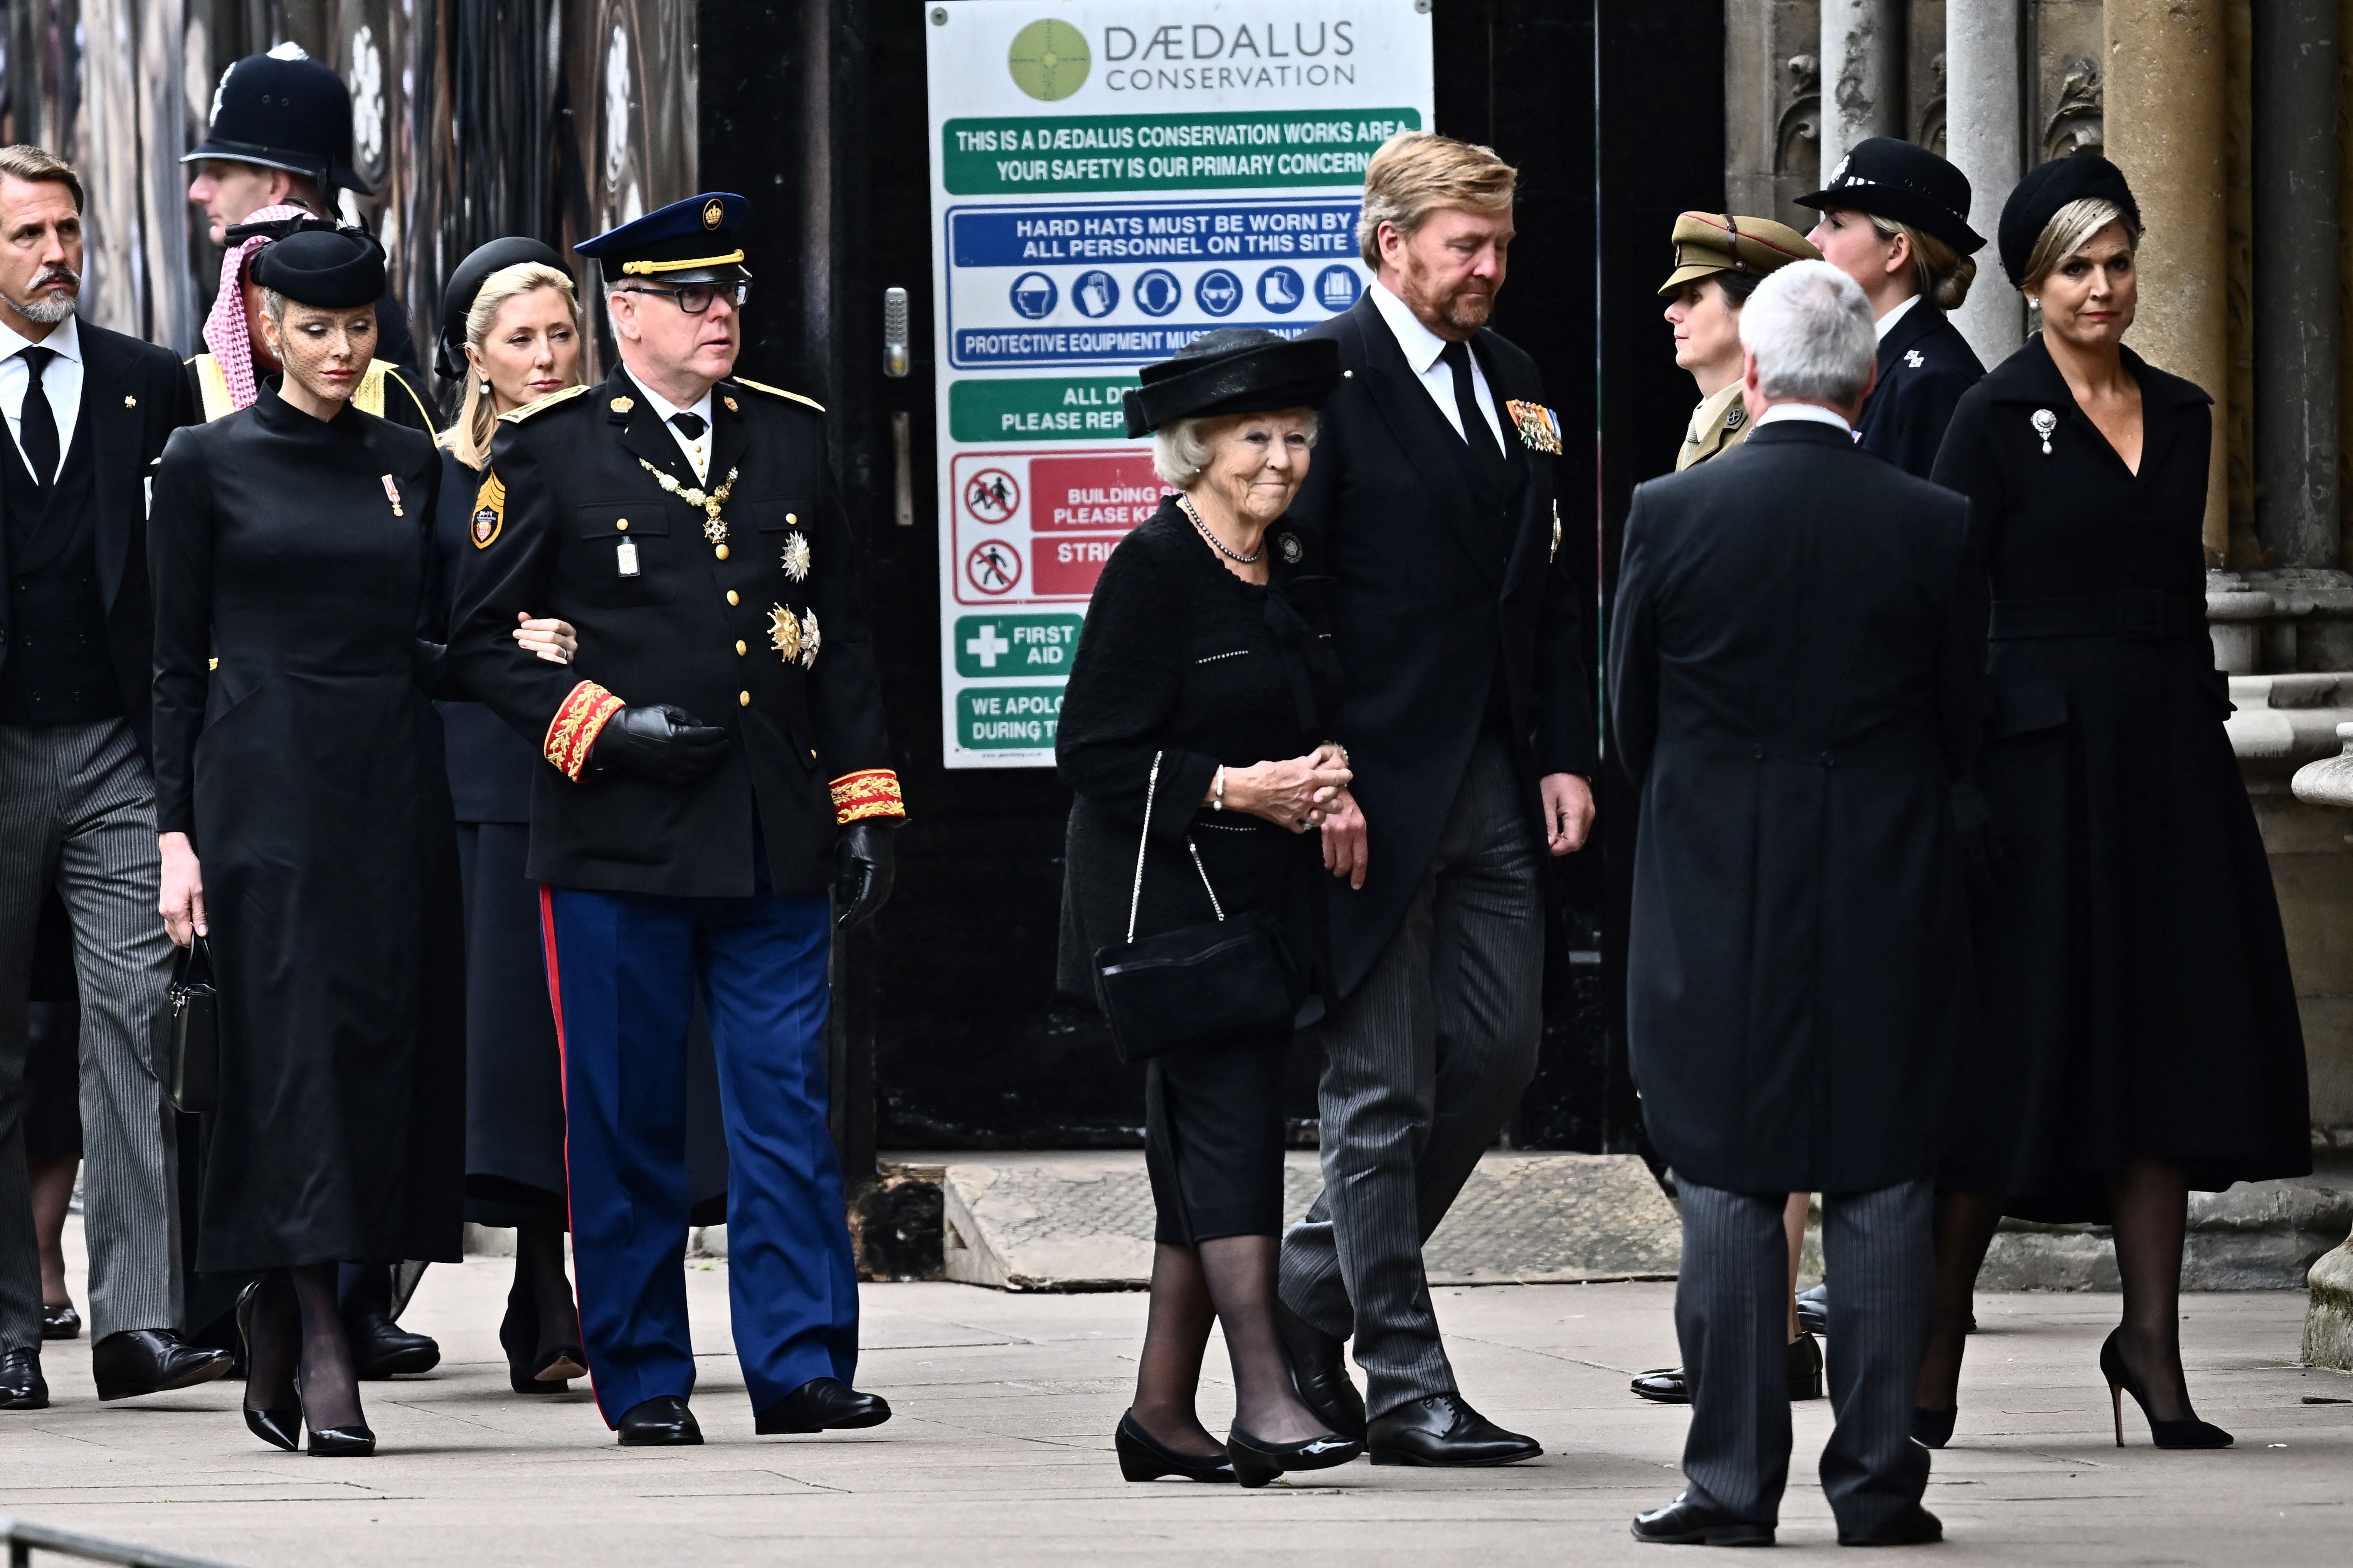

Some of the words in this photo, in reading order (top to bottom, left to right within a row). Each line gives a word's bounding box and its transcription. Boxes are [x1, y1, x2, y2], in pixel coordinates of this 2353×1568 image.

[1105, 20, 1353, 61] DÆDALUS
[1106, 64, 1354, 91] CONSERVATION
[956, 130, 998, 151] THIS
[1001, 130, 1018, 151] IS
[1021, 129, 1034, 150] A
[1038, 126, 1133, 150] DÆDALUS
[1137, 123, 1280, 148] CONSERVATION
[1284, 121, 1354, 144] WORKS
[996, 160, 1048, 181] YOUR
[1051, 158, 1123, 180] SAFETY
[1128, 157, 1145, 178] IS
[1149, 156, 1189, 178] OUR
[1192, 155, 1274, 176] PRIMARY
[1278, 152, 1370, 174] CONCERN
[1017, 219, 1080, 237] HARD
[1084, 217, 1144, 235] HATS
[1148, 215, 1209, 234] MUST
[1214, 215, 1244, 233] BE
[1248, 213, 1318, 232] WORN
[1321, 212, 1351, 230] BY
[1023, 240, 1065, 258] ALL
[1070, 236, 1203, 257] PERSONNEL
[1207, 235, 1240, 254] ON
[1245, 234, 1295, 253] THIS
[1299, 233, 1348, 252] SITE
[965, 333, 1067, 355] PROTECTIVE
[1069, 331, 1163, 352] EQUIPMENT
[1166, 330, 1211, 349] MUS
[1063, 387, 1102, 406] ALL
[1002, 412, 1081, 431] PLEASE
[1068, 486, 1156, 505] BUILDING
[1054, 506, 1129, 524] PLEASE
[1014, 625, 1075, 644] FIRST
[1027, 646, 1064, 664] AID
[972, 697, 1001, 715] WE
[972, 720, 1041, 740] DURING
